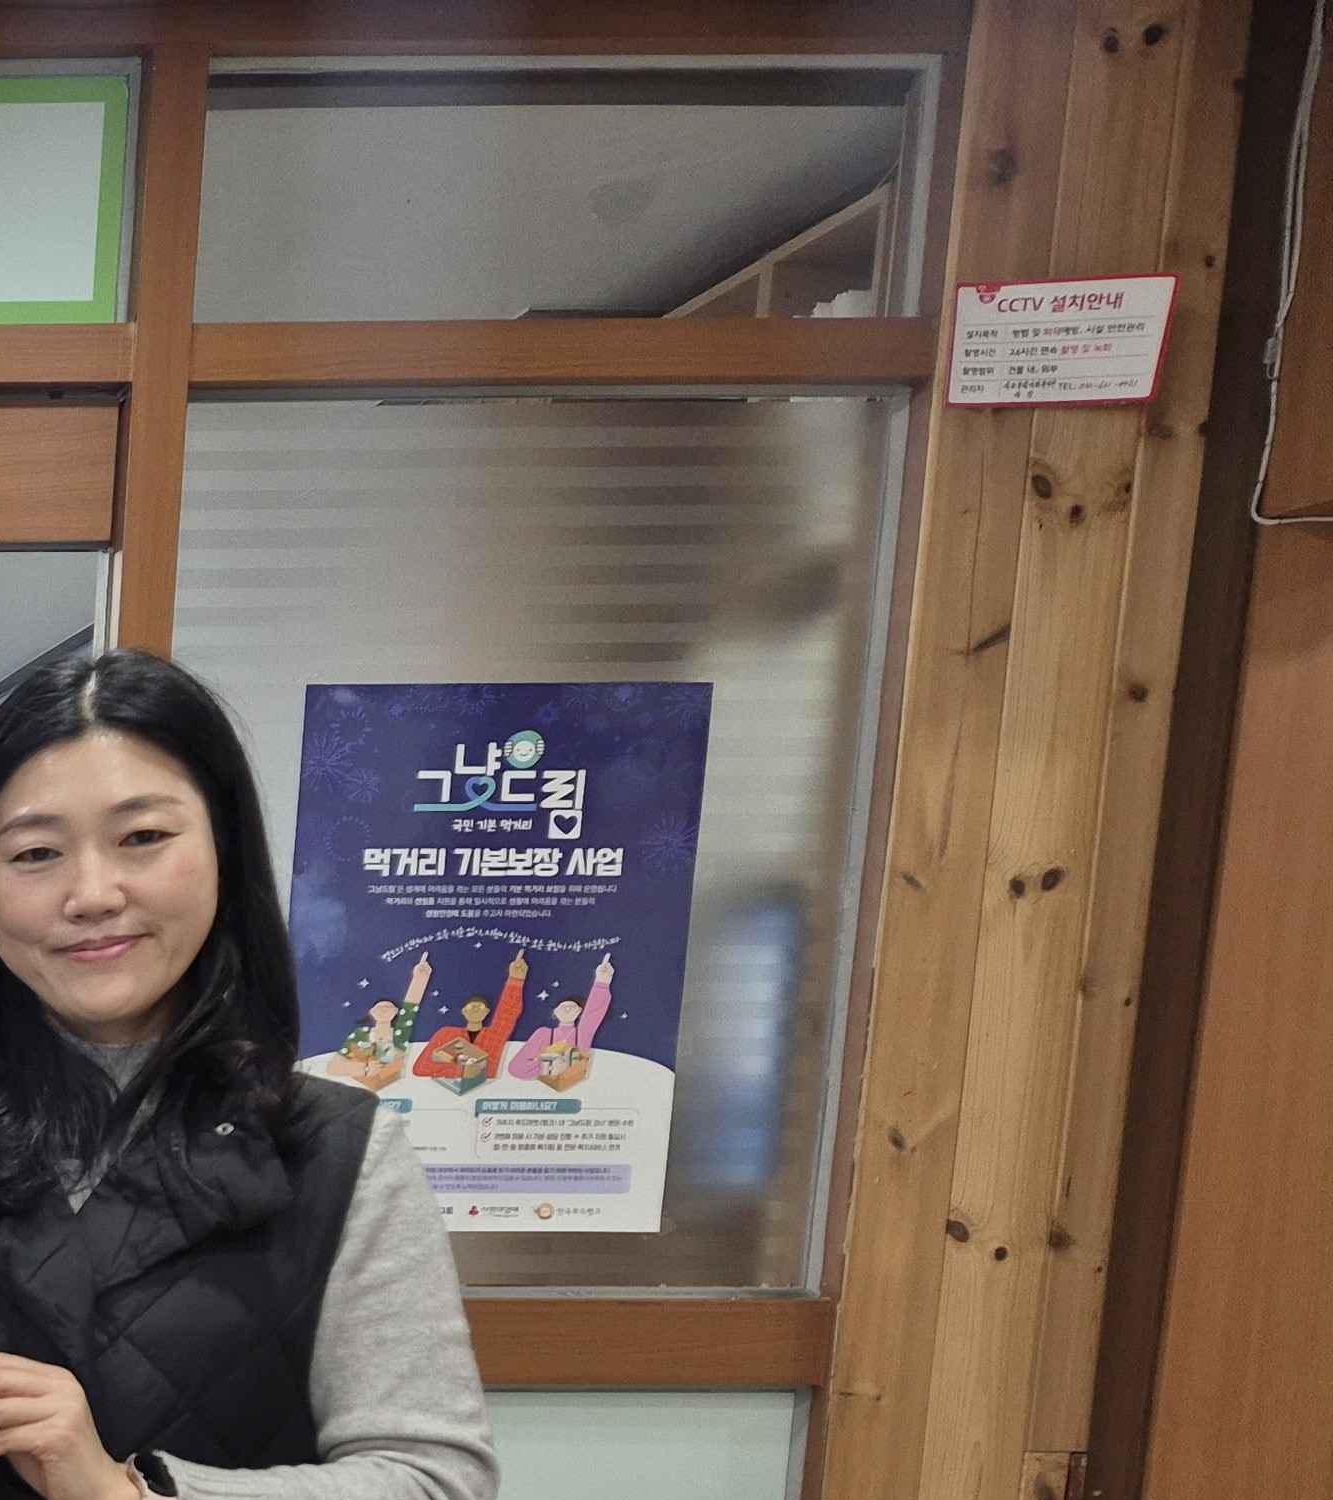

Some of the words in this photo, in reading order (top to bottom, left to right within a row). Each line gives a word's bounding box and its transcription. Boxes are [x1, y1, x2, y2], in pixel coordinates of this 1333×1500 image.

[997, 297, 1044, 313] CCTV
[1050, 291, 1125, 314] 설치안내
[413, 743, 587, 839] 그냥드림
[451, 818, 475, 833] 국민
[476, 818, 497, 833] 기본
[500, 818, 533, 833] 먹거리
[362, 847, 447, 877] 먹거리
[452, 847, 563, 878] 기본보장
[565, 847, 625, 877] 사업
